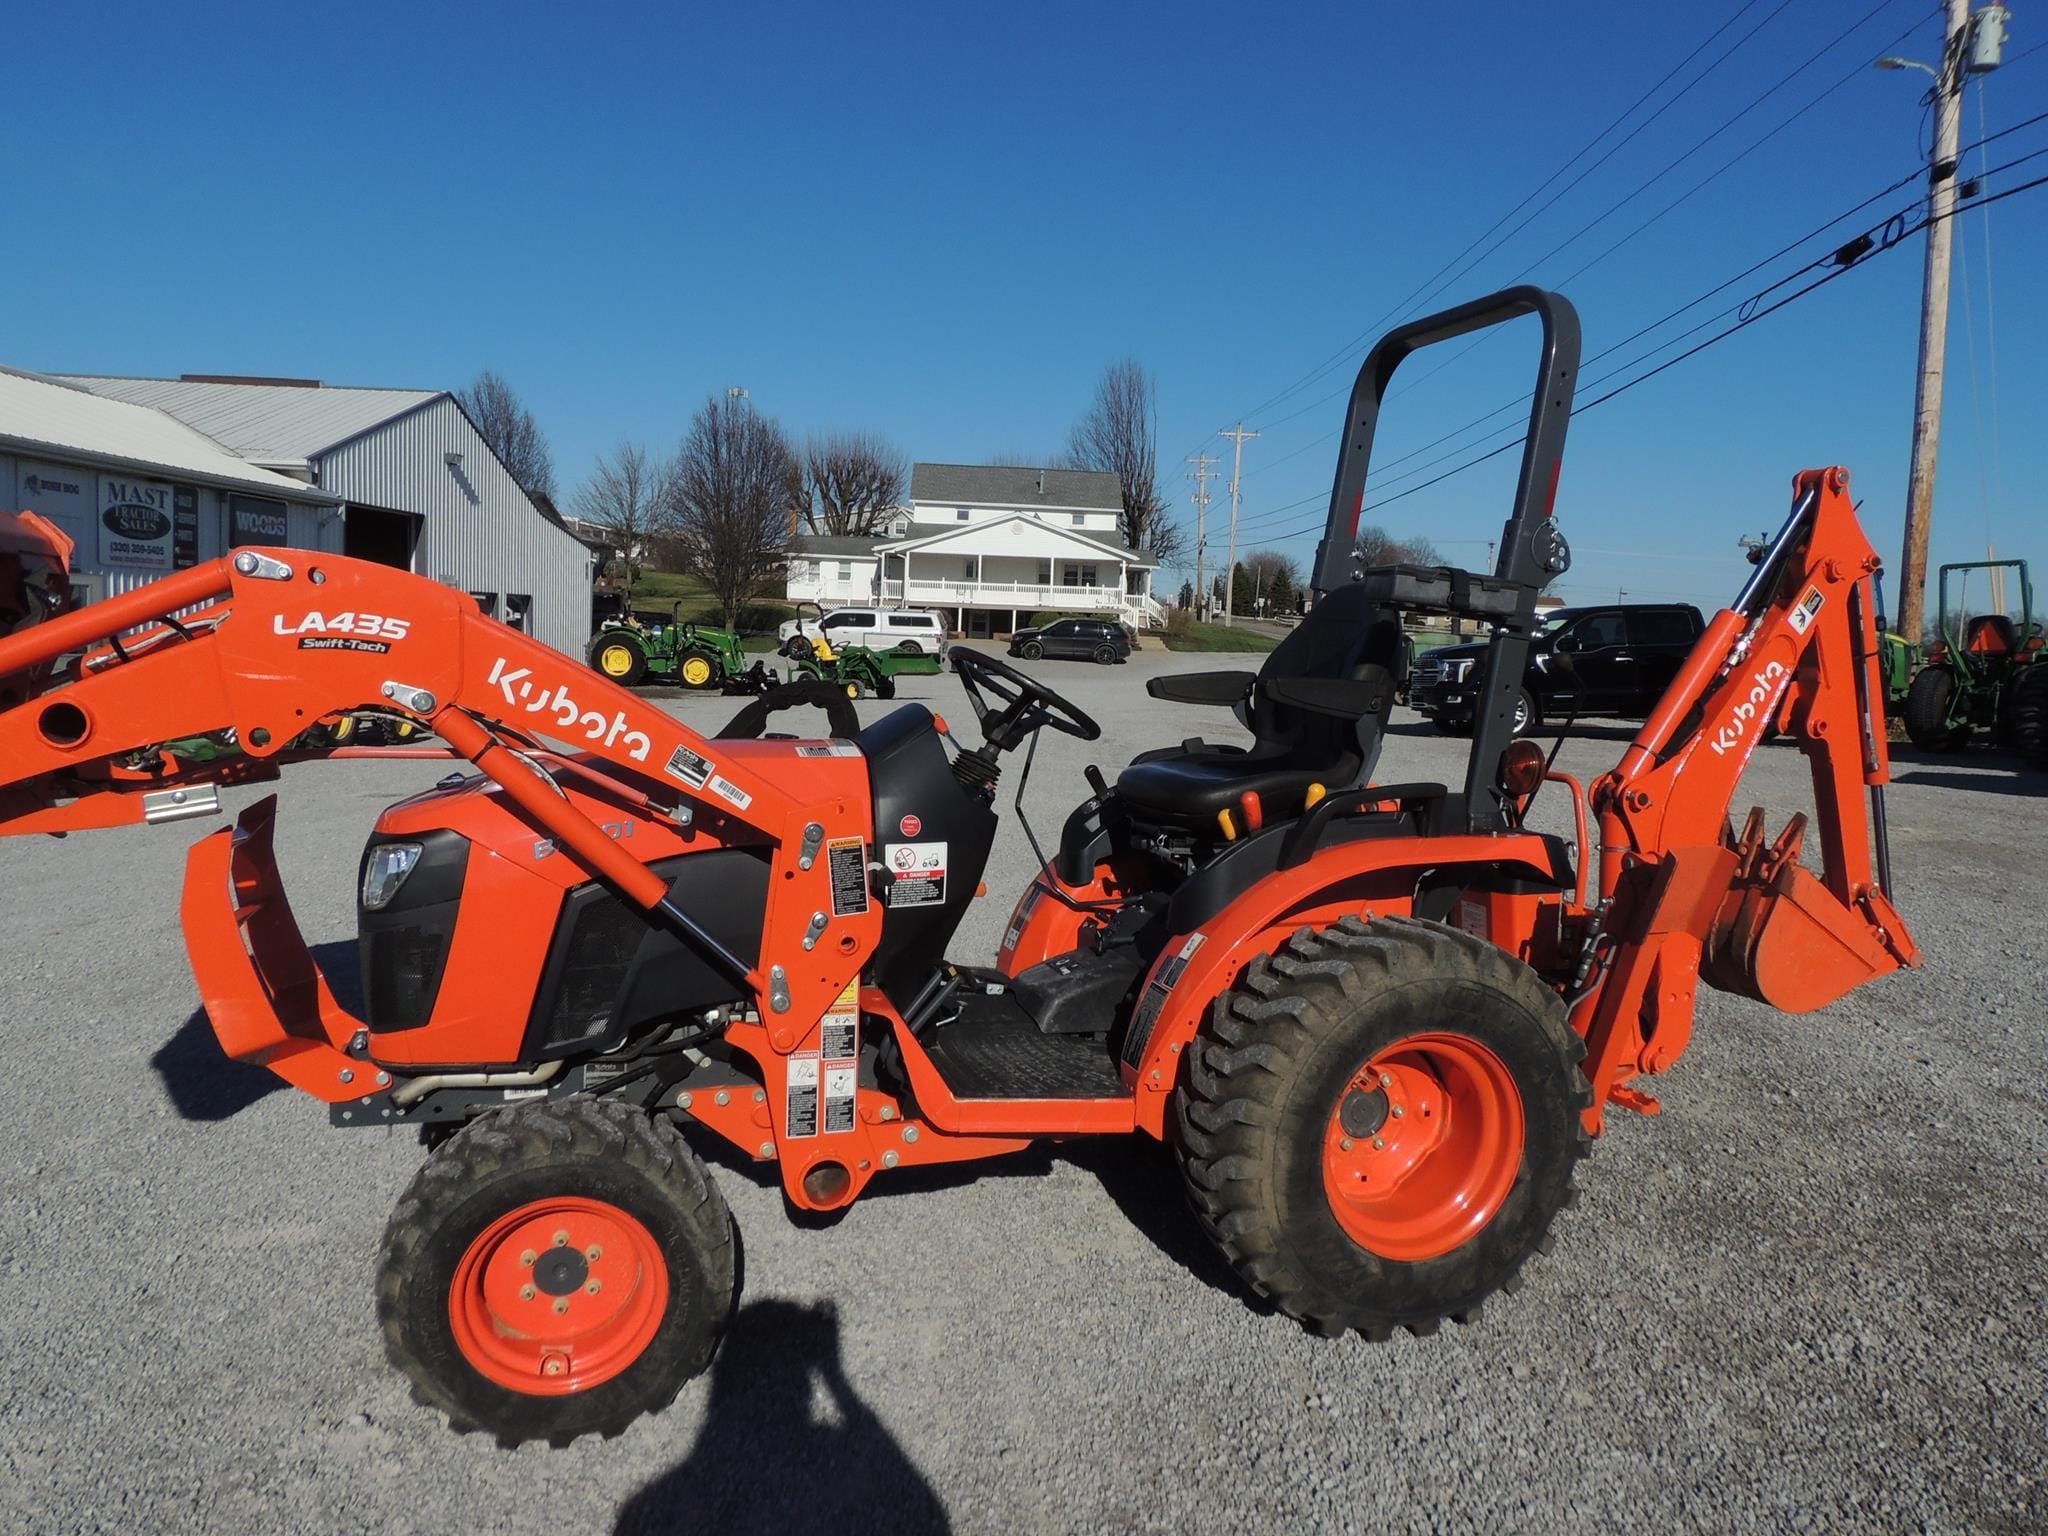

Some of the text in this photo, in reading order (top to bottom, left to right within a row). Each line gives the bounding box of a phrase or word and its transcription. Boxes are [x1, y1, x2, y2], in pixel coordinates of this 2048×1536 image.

[108, 481, 168, 508] MAST
[114, 504, 159, 521] TRACTOR
[119, 517, 157, 531] SALES
[236, 511, 286, 536] WOODS
[273, 611, 412, 640] LA435
[302, 638, 387, 653] Swift-Tach
[487, 657, 652, 761] Kubota
[1711, 661, 1784, 756] Kubota
